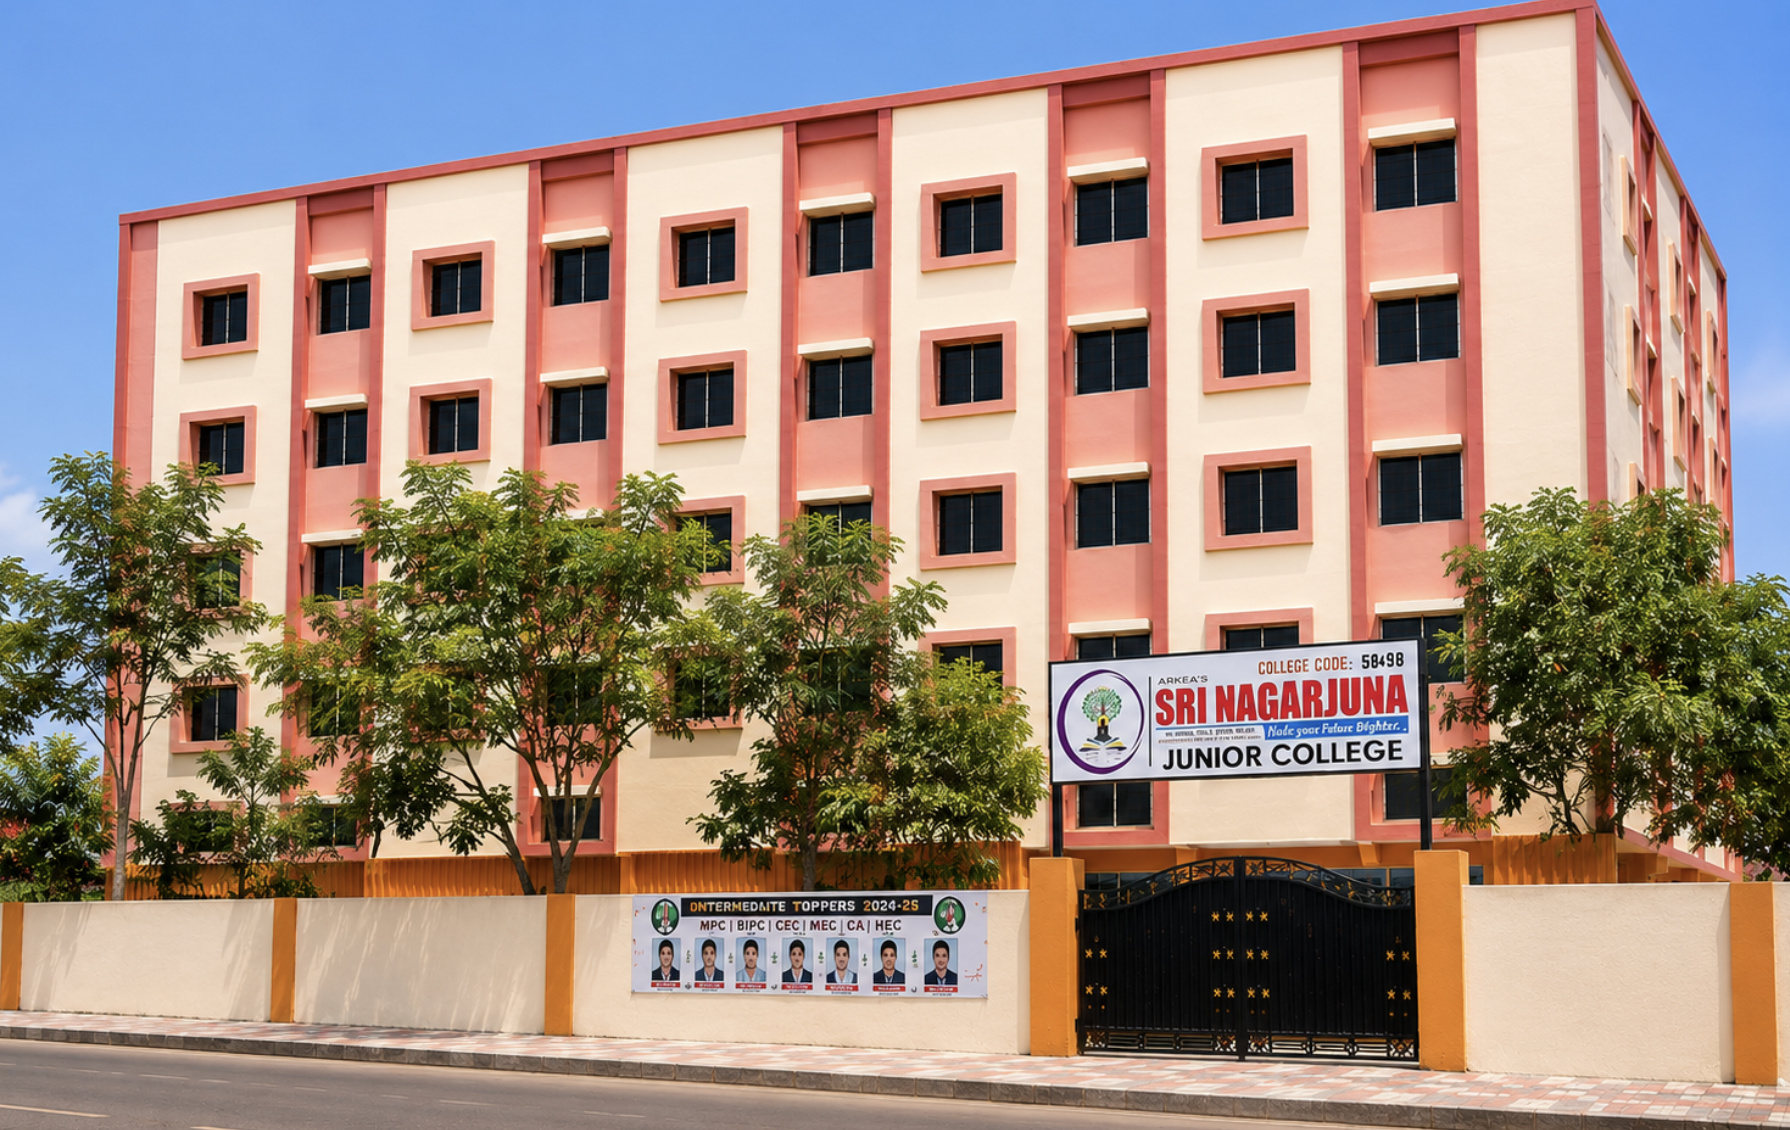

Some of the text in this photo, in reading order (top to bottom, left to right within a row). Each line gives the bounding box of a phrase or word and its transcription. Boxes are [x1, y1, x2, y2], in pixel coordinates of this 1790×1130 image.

[1258, 652, 1404, 675] COLLEGE CODE: 58498
[1158, 675, 1208, 685] ARKEA'S
[1155, 674, 1409, 726] SRI NAGARJUNA
[1162, 740, 1403, 770] JUNIOR COLLEGE
[792, 900, 855, 912] TOPPERS
[700, 919, 902, 931] MPC BIPC CEC MEC CA HEC
